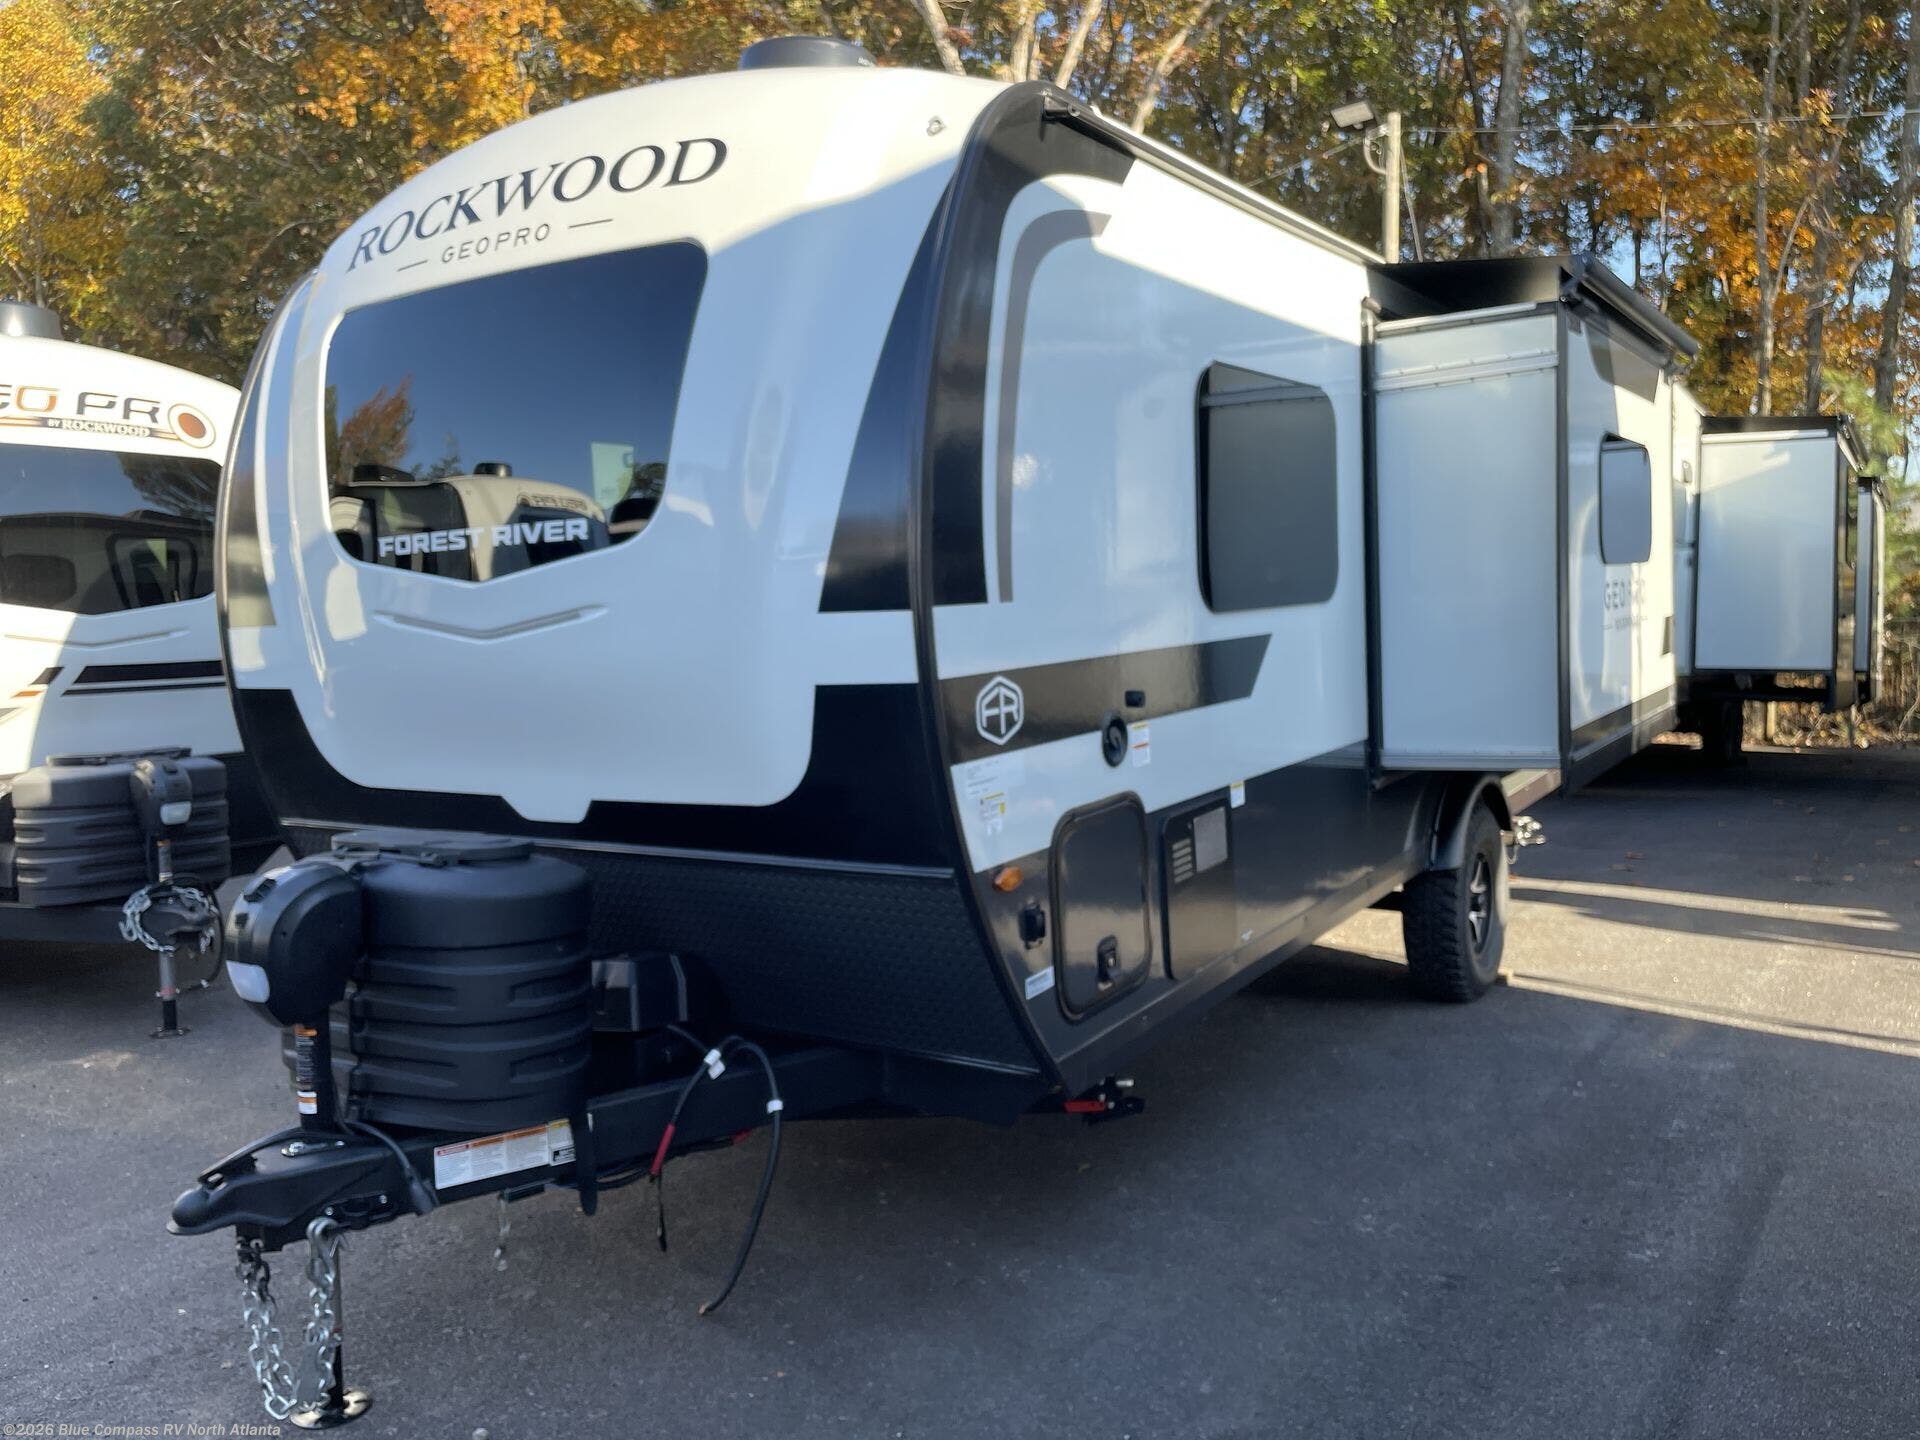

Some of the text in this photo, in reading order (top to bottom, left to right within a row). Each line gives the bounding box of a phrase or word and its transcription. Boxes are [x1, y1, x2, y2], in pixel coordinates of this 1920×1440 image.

[347, 137, 728, 273] ROCKWOOD
[441, 223, 551, 264] GEOPRO
[62, 419, 151, 438] ROCKWOOD
[377, 517, 589, 558] FOREST RIVER
